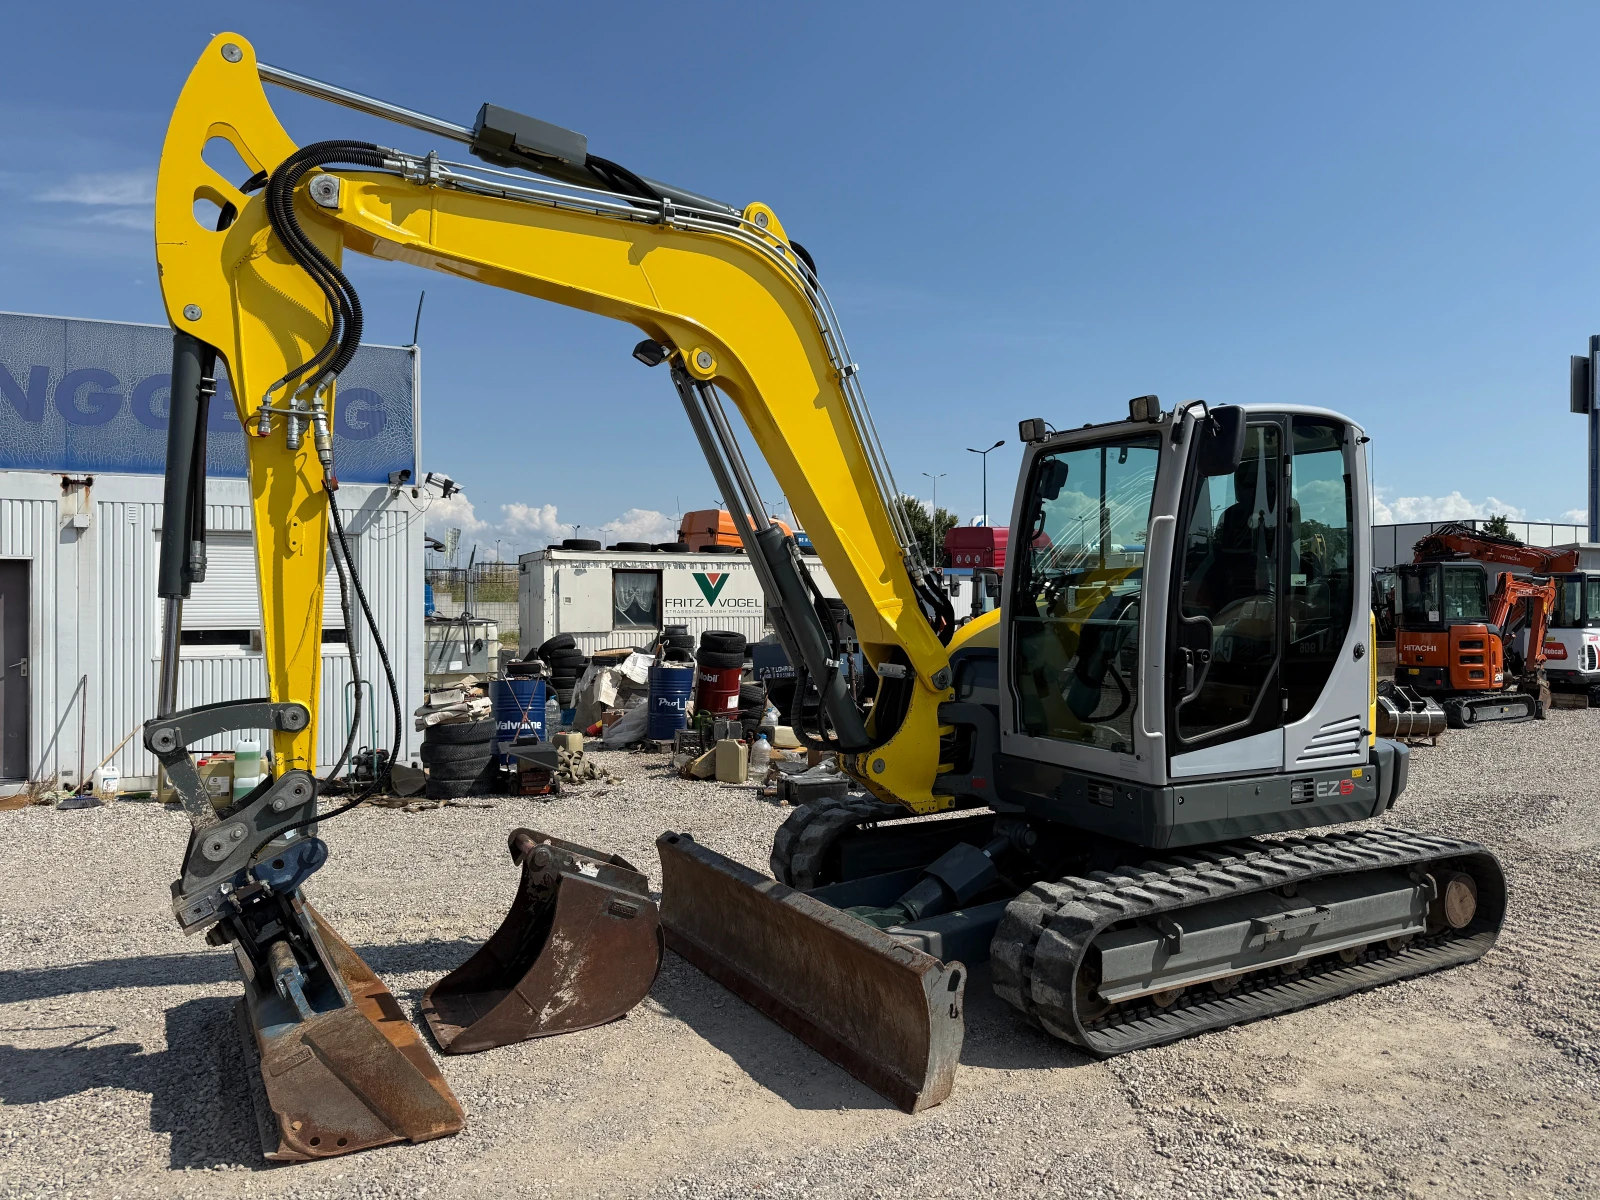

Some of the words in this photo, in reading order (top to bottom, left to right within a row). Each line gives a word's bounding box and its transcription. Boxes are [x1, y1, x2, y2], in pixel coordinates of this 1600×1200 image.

[665, 598, 704, 607] FRITZ
[718, 598, 762, 607] VOGEL
[1403, 644, 1437, 652] HITACHI
